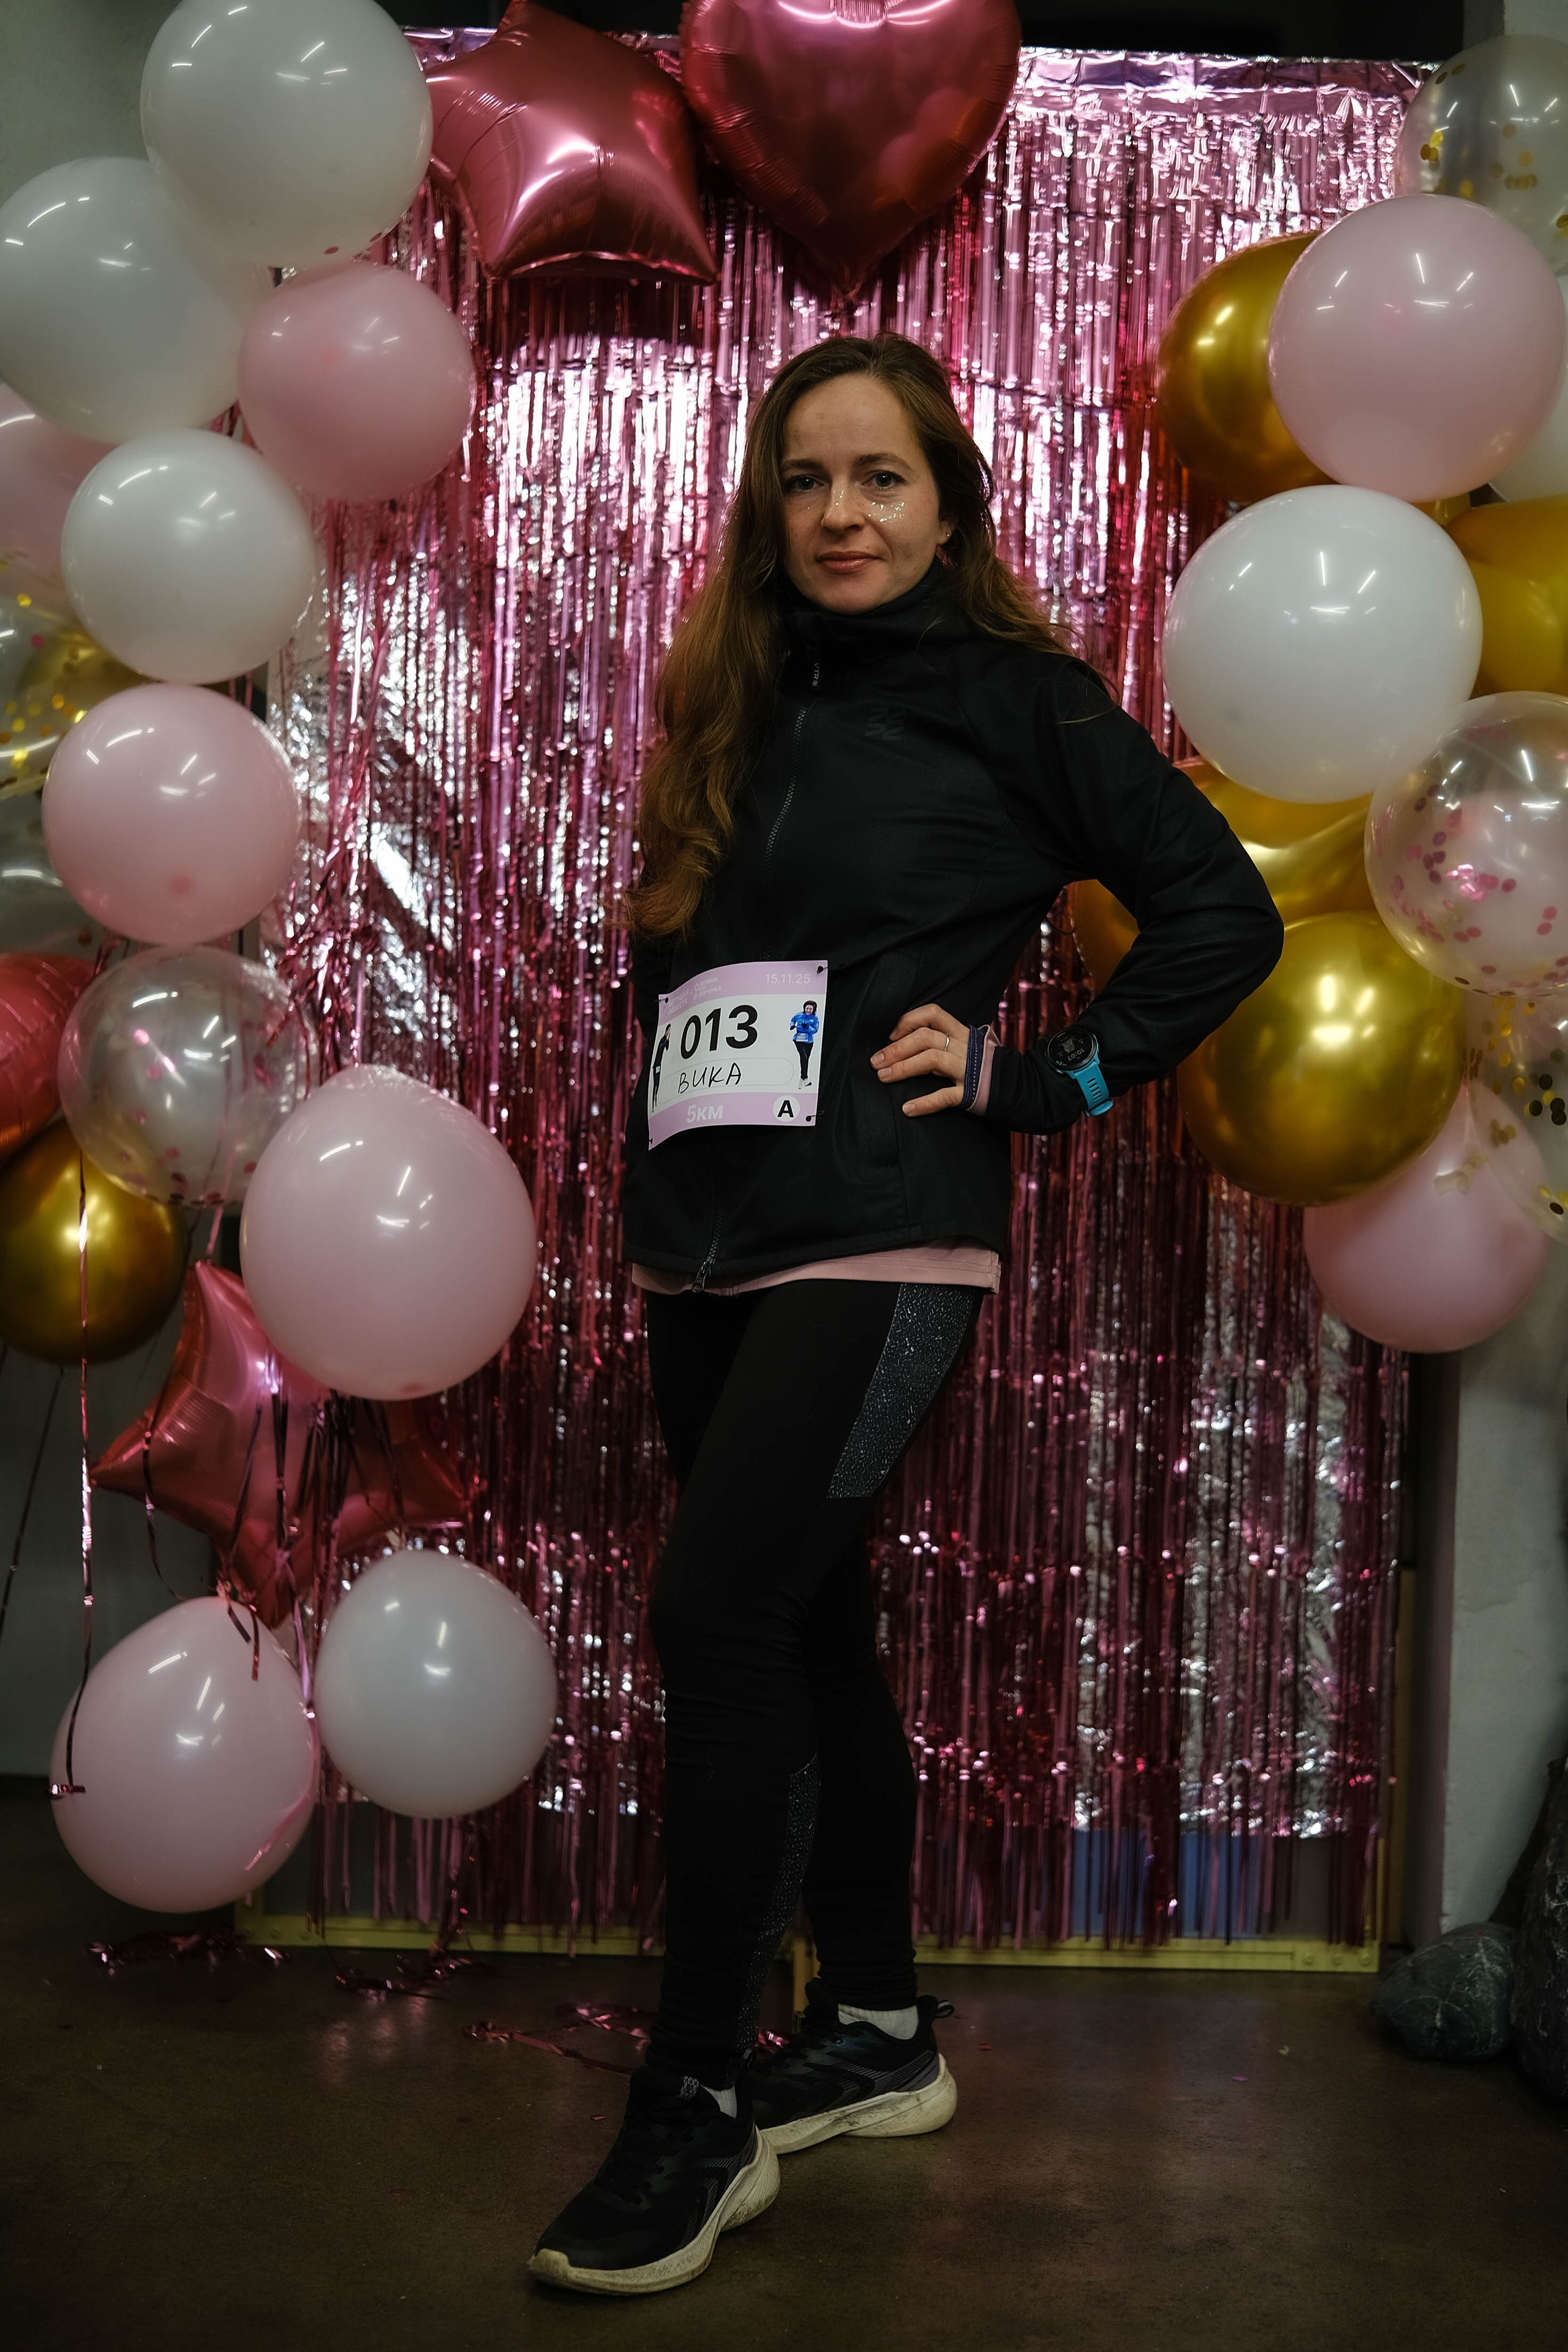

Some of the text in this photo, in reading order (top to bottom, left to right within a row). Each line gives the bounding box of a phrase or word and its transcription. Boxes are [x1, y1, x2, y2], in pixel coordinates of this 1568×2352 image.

[764, 973, 811, 984] 15.11.25
[680, 1005, 758, 1060] 013
[1068, 1048, 1085, 1061] 10:07
[678, 1063, 742, 1094] ВИКА
